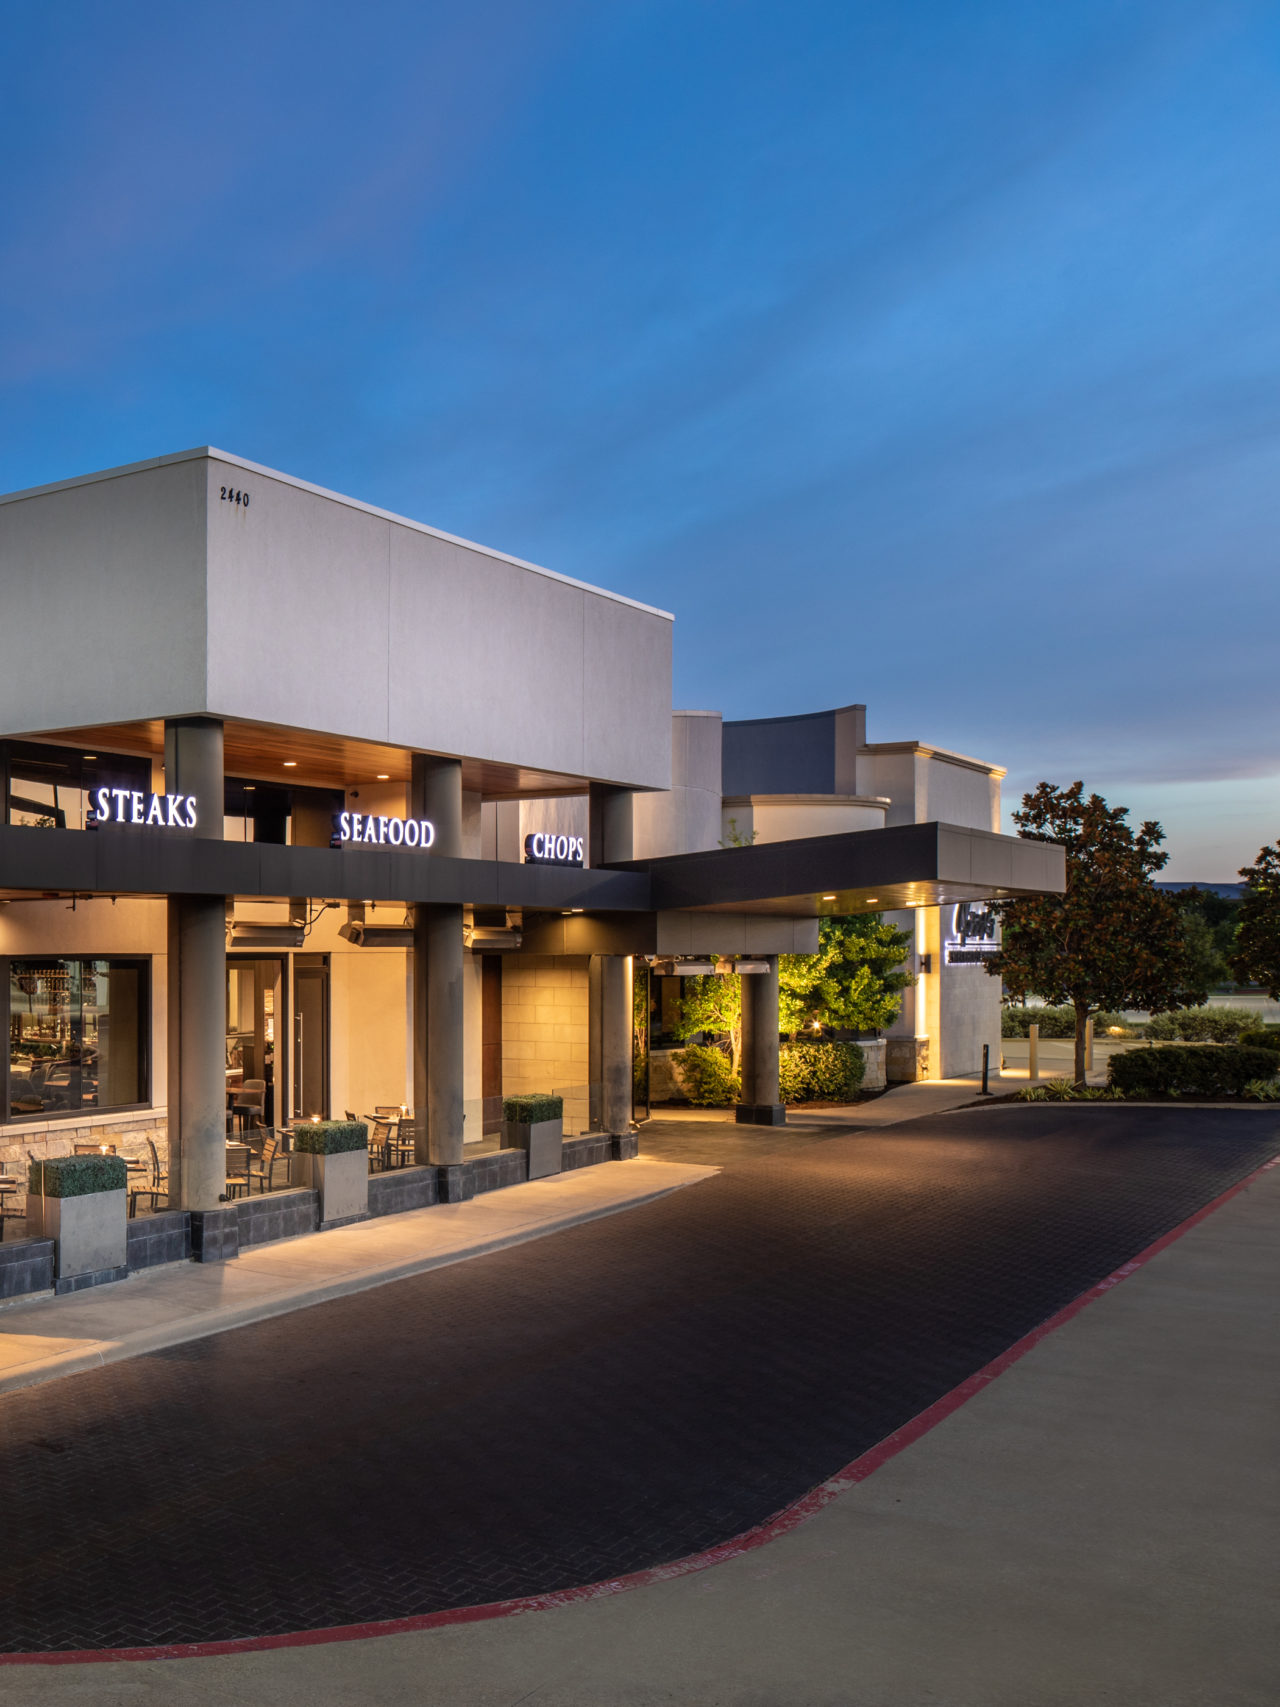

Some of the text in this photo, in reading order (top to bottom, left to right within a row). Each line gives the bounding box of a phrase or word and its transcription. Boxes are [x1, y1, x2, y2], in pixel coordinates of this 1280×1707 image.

[221, 487, 250, 507] 2440
[97, 788, 197, 828] STEAKS
[340, 812, 435, 847] SEAFOOD
[532, 833, 583, 861] CHOPS
